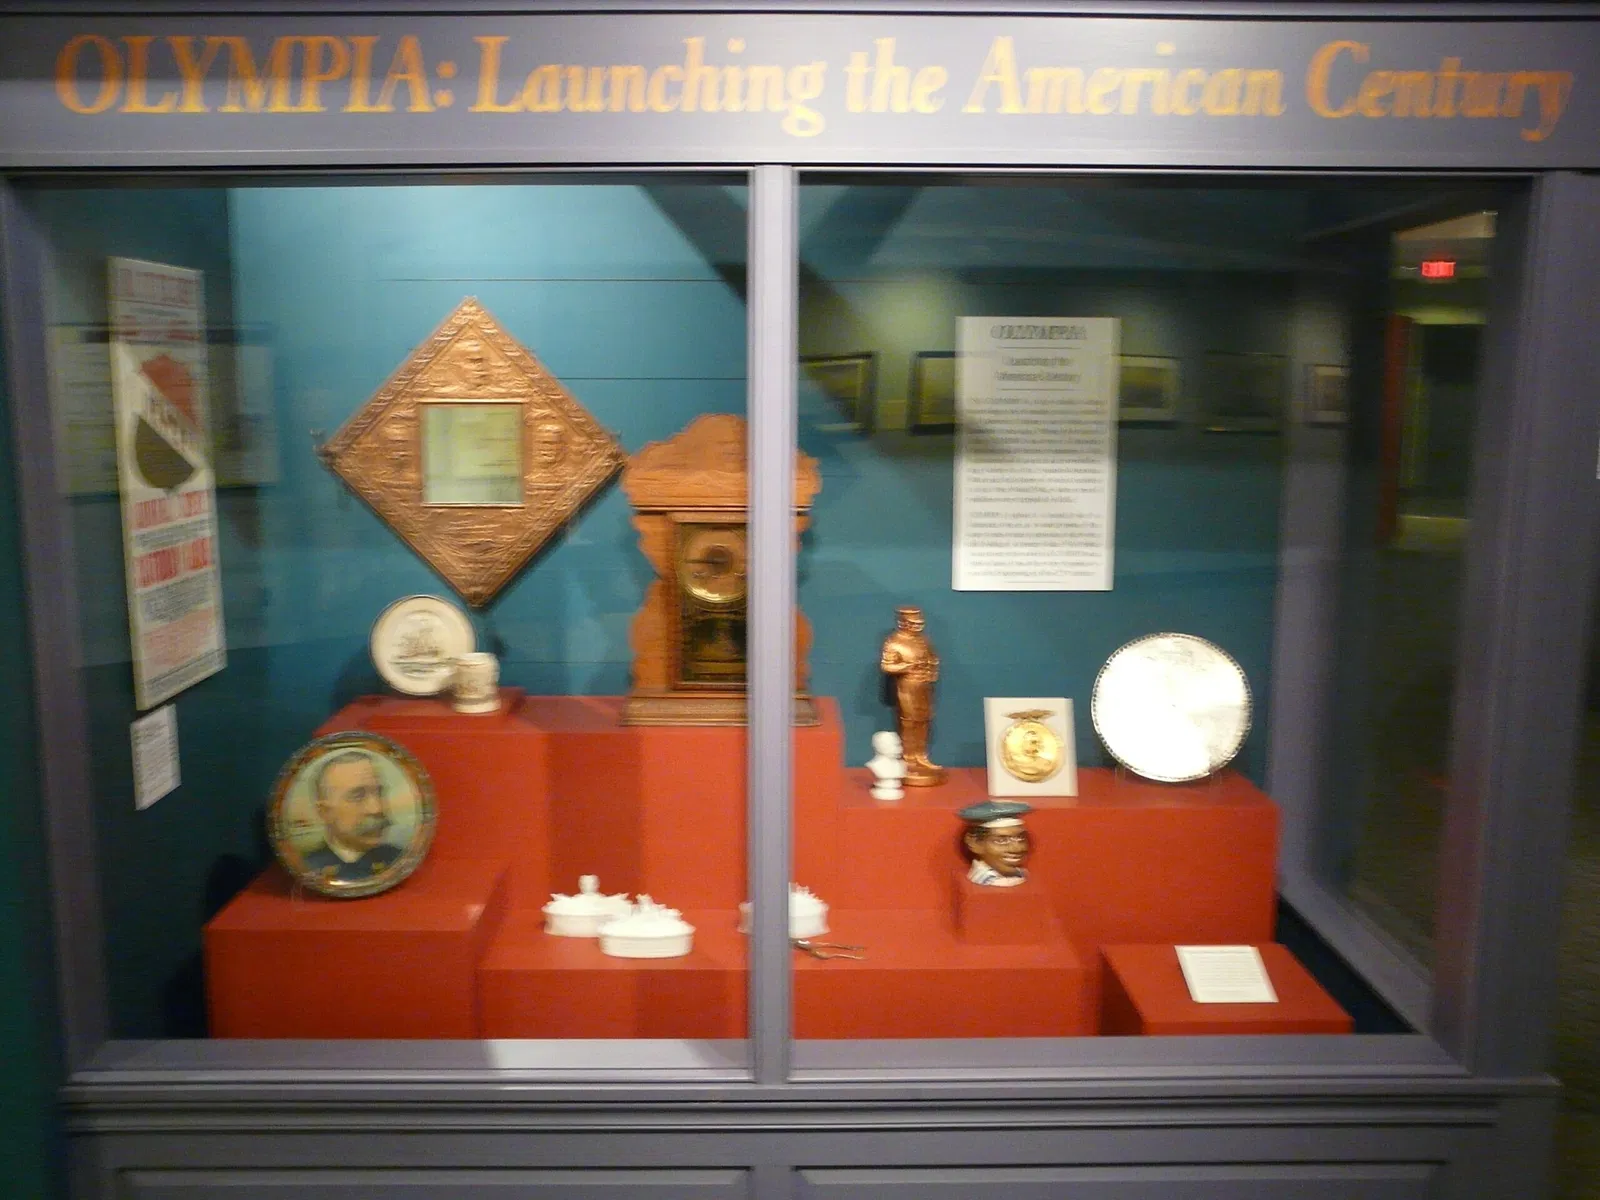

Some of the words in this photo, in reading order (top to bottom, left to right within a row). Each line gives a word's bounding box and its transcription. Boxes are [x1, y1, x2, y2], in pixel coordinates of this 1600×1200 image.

[56, 34, 455, 114] OLYMPIA:
[468, 35, 828, 137] Launching
[844, 37, 949, 114] the
[963, 36, 1286, 117] American
[1307, 40, 1574, 142] Century
